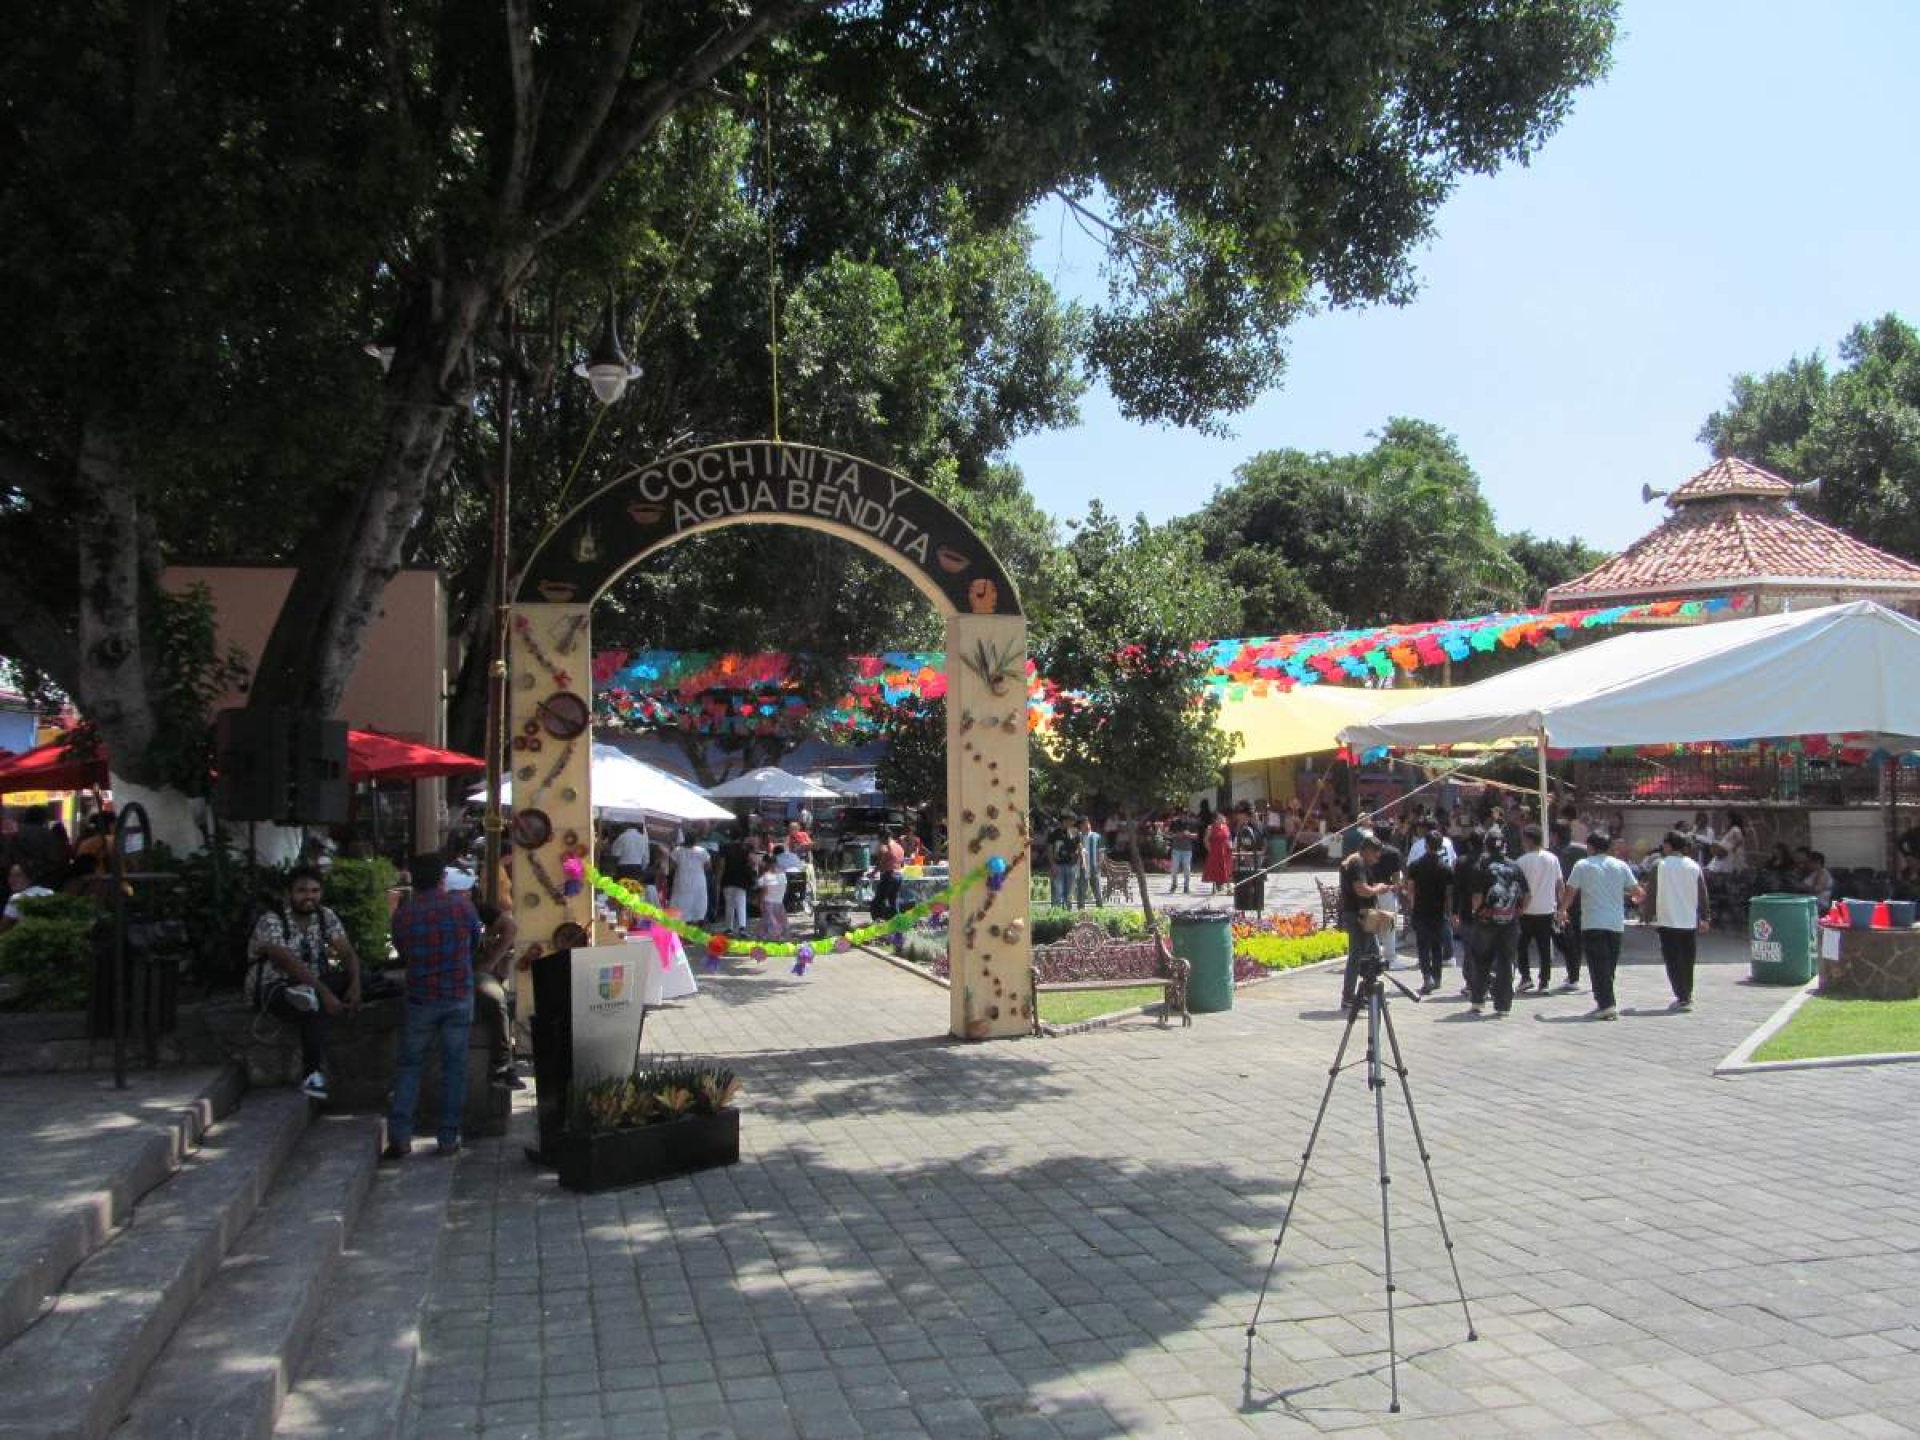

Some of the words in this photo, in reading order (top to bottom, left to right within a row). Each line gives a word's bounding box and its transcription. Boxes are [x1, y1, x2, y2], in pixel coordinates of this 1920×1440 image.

[639, 446, 860, 501] COCHINITA
[887, 477, 913, 509] Y
[673, 479, 777, 532] AGUA
[786, 479, 931, 565] BENDITA
